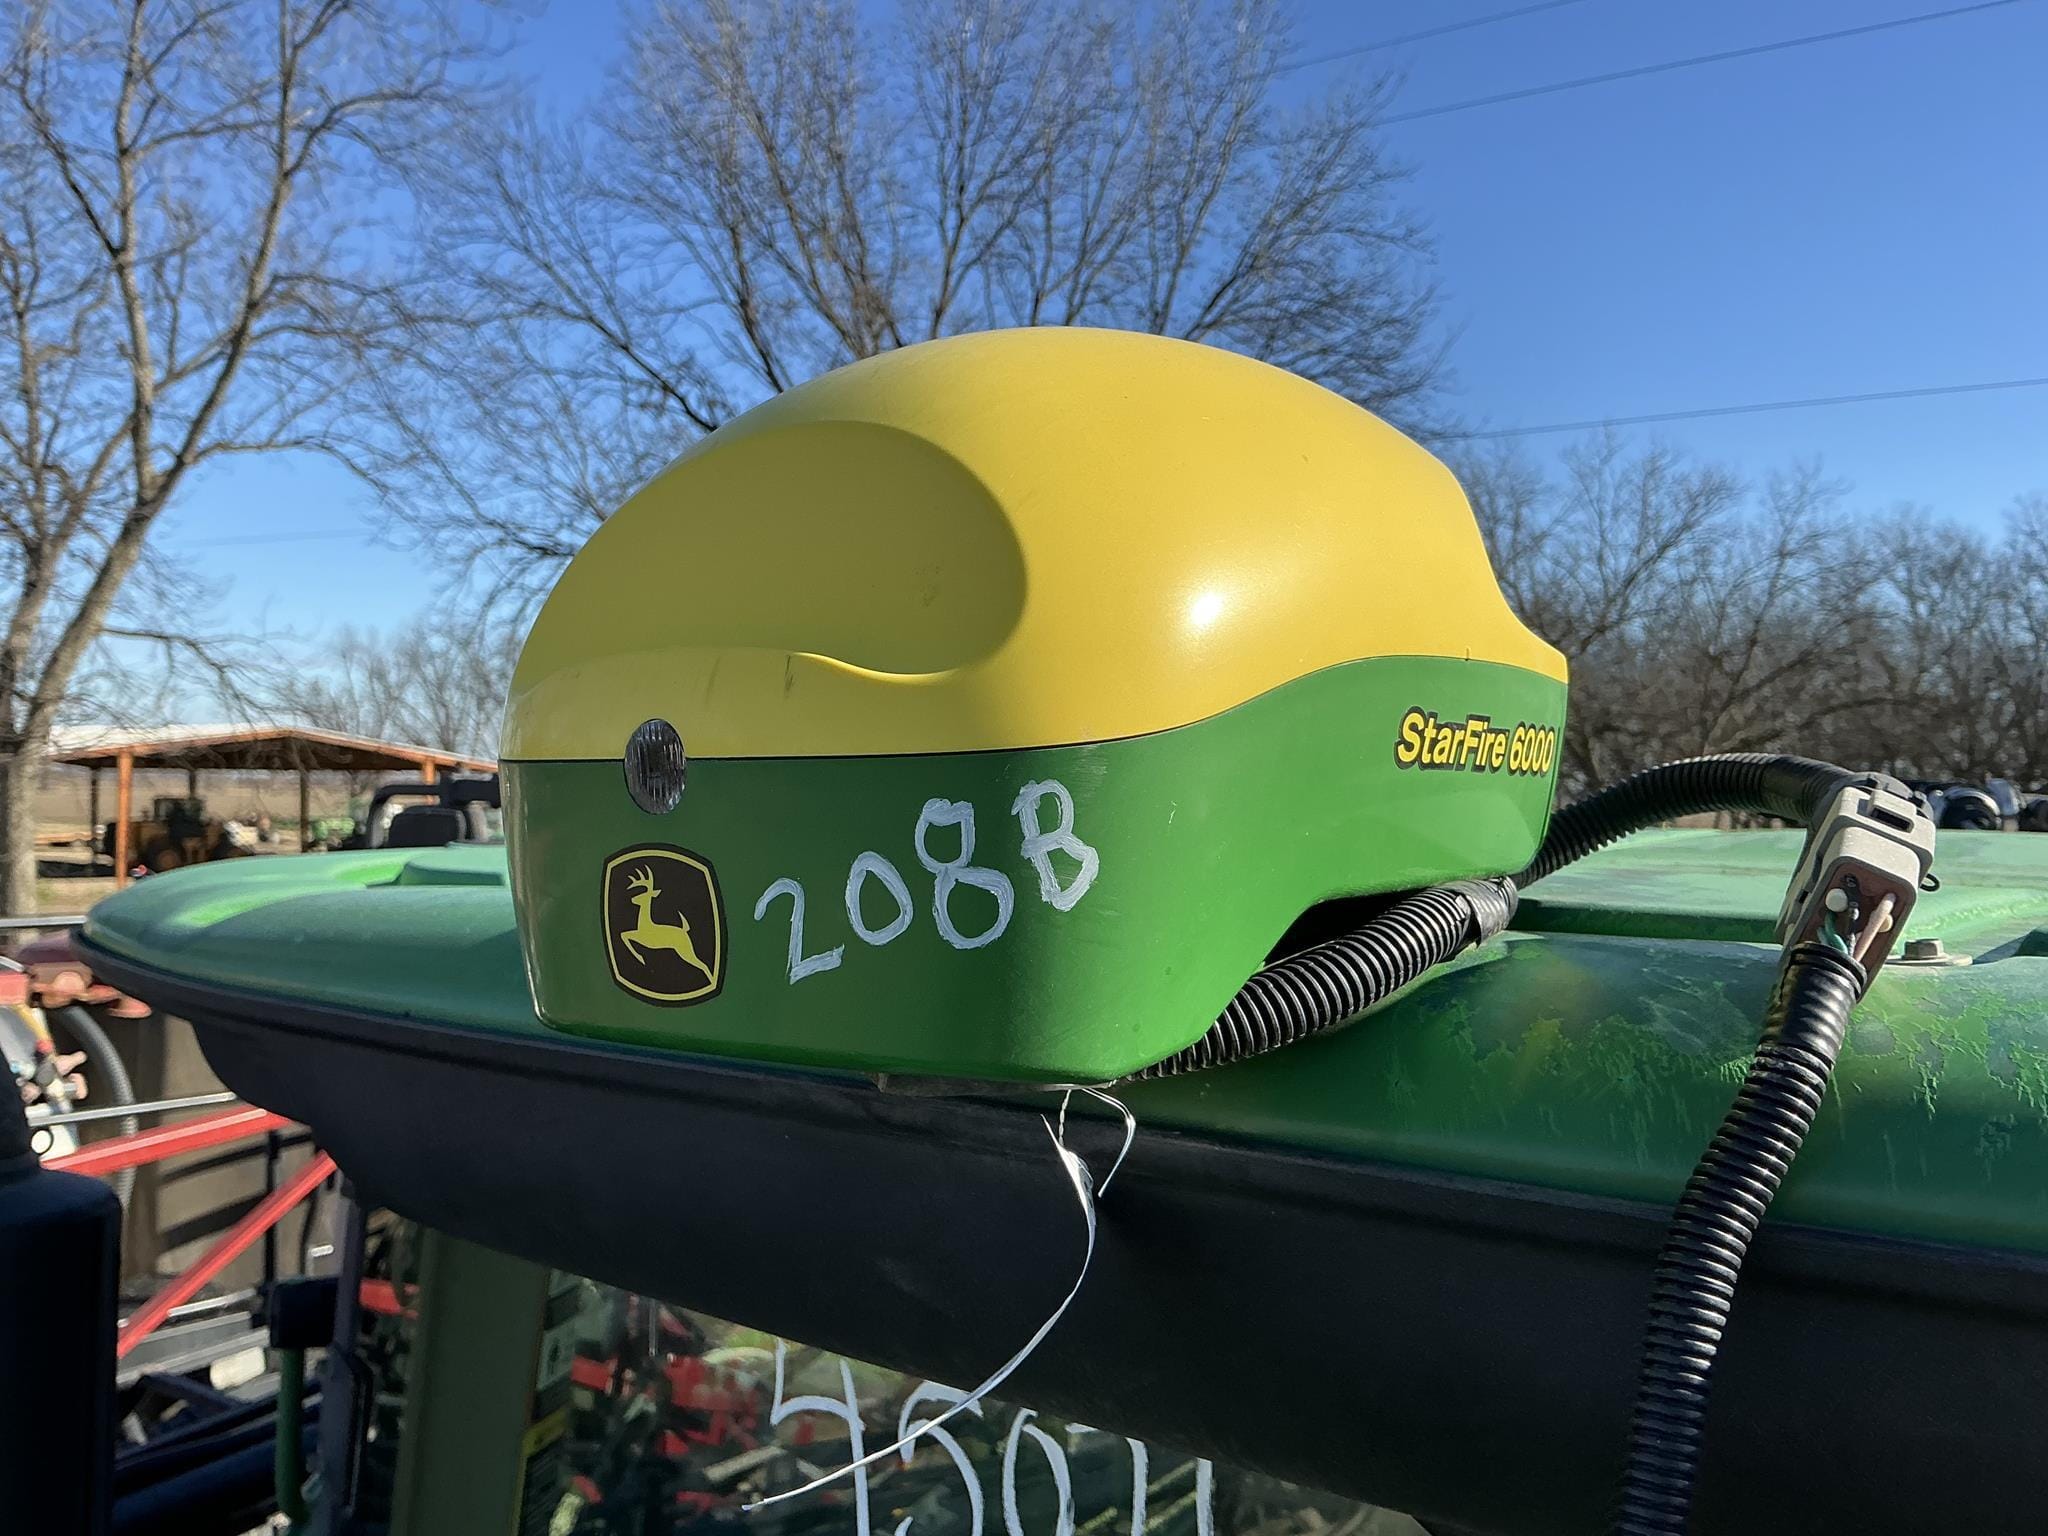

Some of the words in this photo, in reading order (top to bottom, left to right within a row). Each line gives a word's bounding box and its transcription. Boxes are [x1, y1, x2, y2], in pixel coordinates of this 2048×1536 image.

[1395, 706, 1509, 773] StarFire
[1508, 721, 1555, 777] 6000
[755, 779, 1099, 985] 208B
